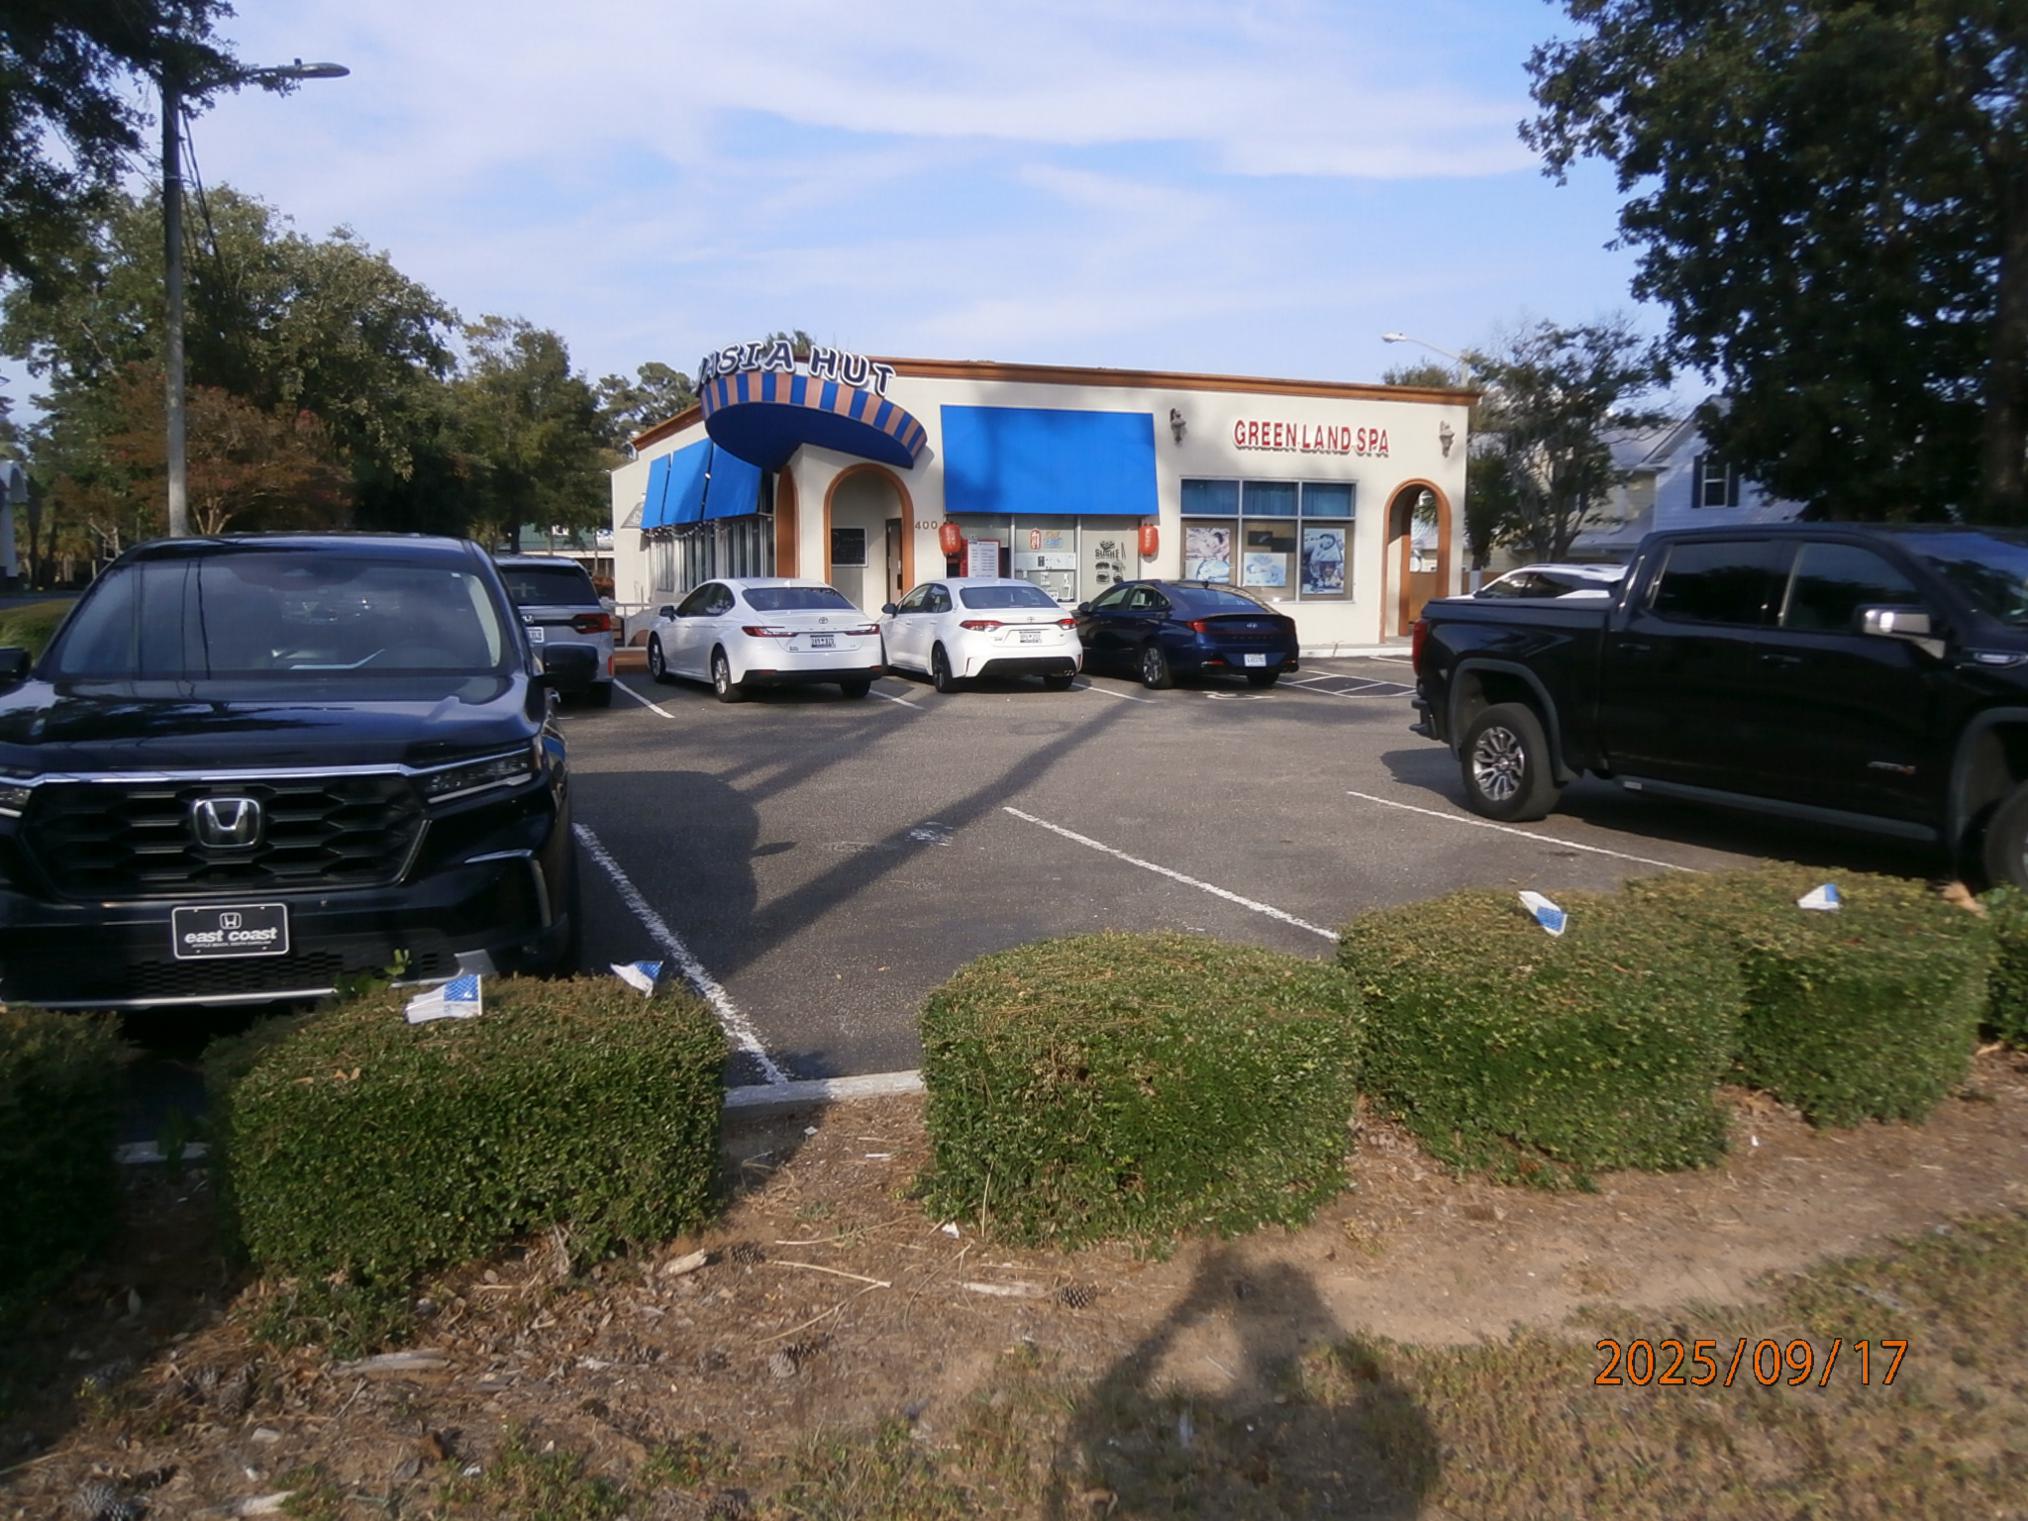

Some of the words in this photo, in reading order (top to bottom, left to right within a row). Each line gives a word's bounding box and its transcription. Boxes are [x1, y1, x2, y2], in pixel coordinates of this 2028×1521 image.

[699, 340, 796, 385] ASIA
[809, 345, 896, 397] HUT
[1356, 427, 1390, 453] SPA
[914, 520, 938, 530] 400
[184, 929, 224, 943] east
[228, 926, 278, 942] coast
